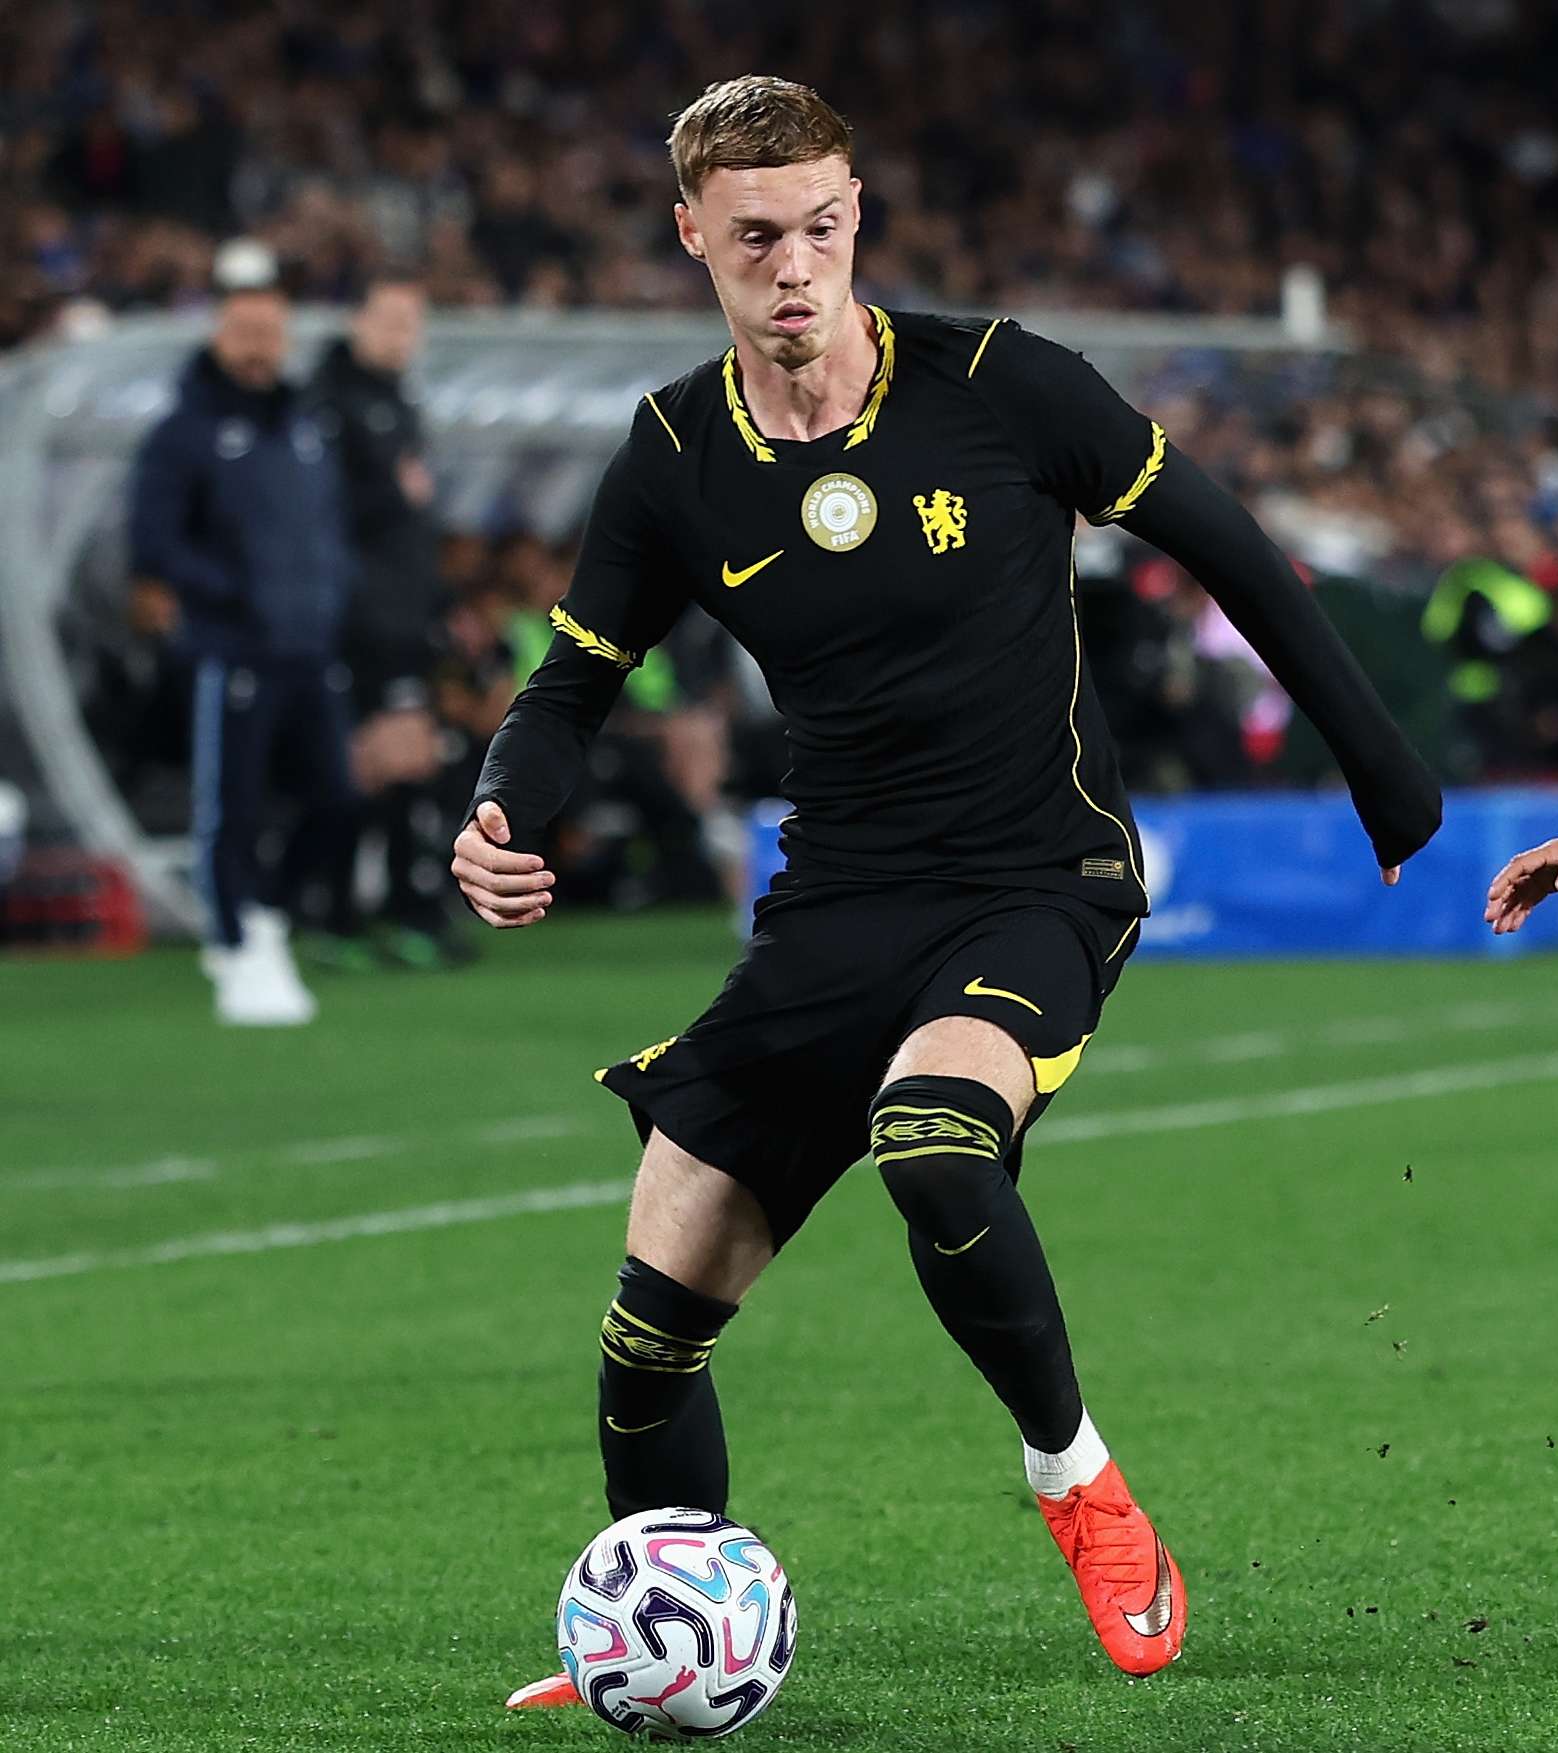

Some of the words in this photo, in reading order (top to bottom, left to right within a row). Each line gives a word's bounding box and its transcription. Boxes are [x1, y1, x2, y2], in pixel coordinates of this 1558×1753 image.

[807, 490, 822, 529] WORLD
[821, 480, 871, 514] CHAMPIONS
[831, 530, 860, 547] FIFA
